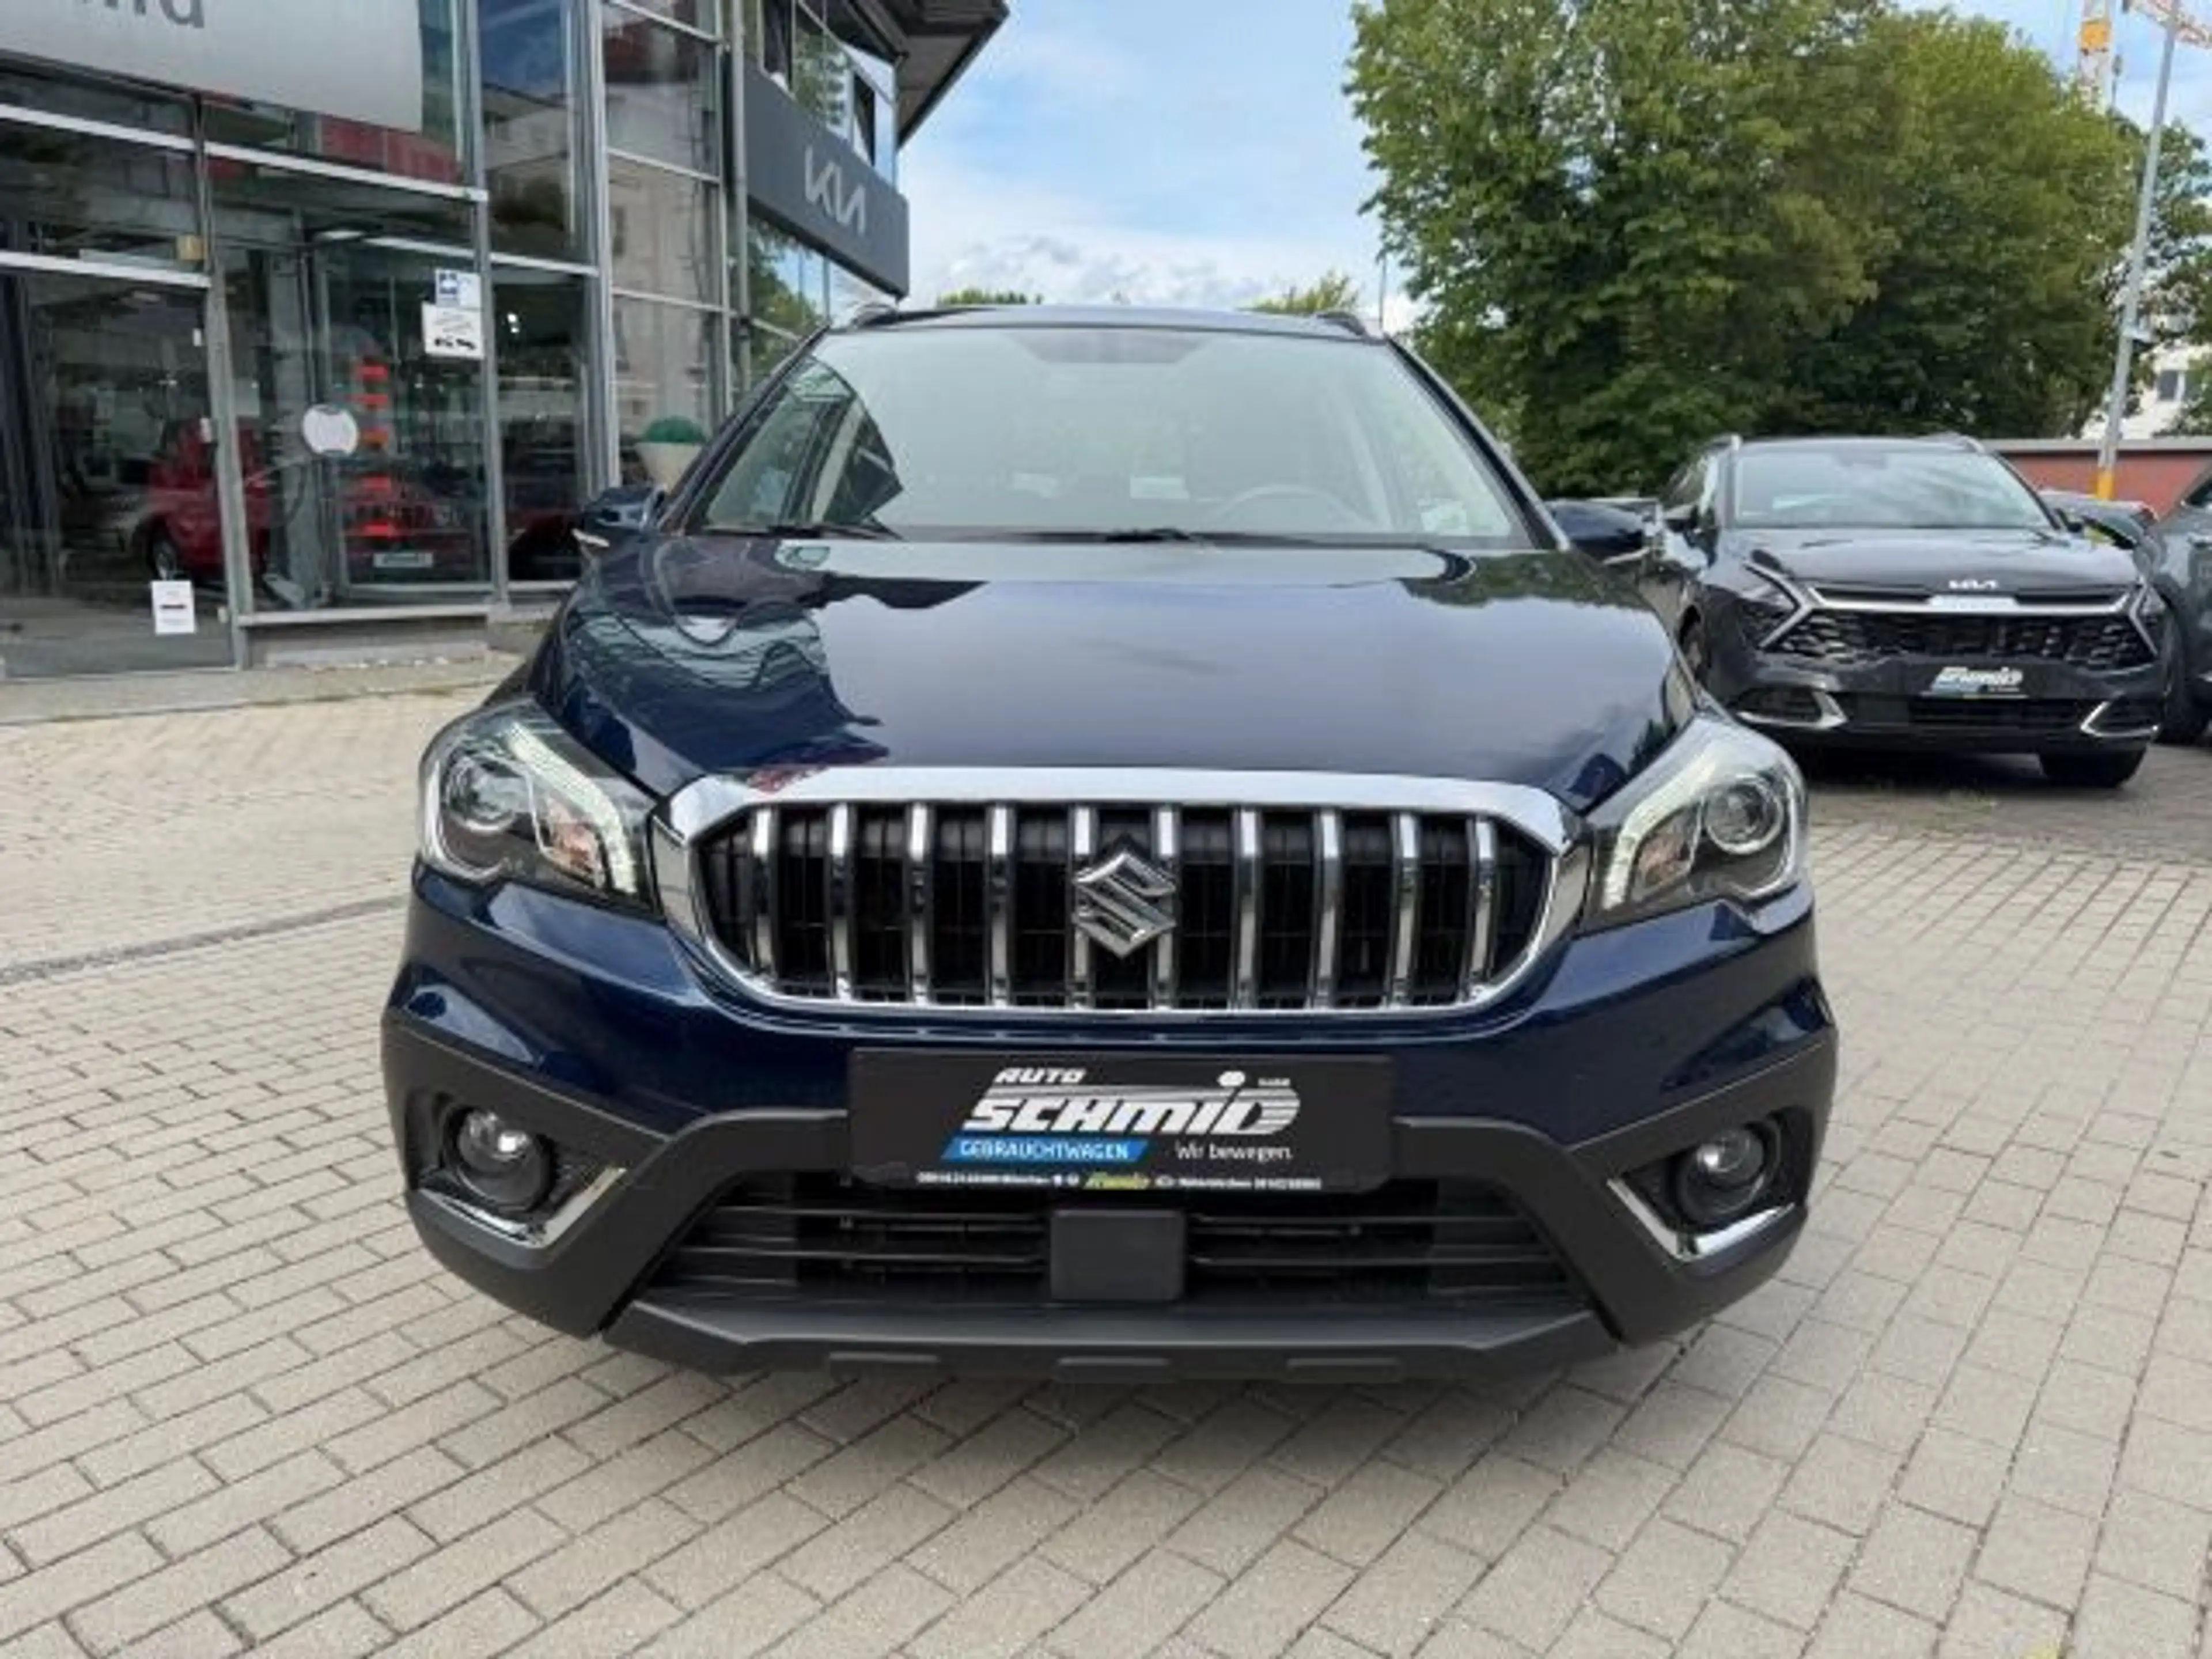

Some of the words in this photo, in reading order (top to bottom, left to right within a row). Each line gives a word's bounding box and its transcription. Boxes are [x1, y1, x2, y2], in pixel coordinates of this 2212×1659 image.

[994, 1067, 1086, 1084] AUTO
[960, 1140, 1128, 1160] GEBRAUCHTWAGEN
[1175, 1139, 1203, 1160] Wir
